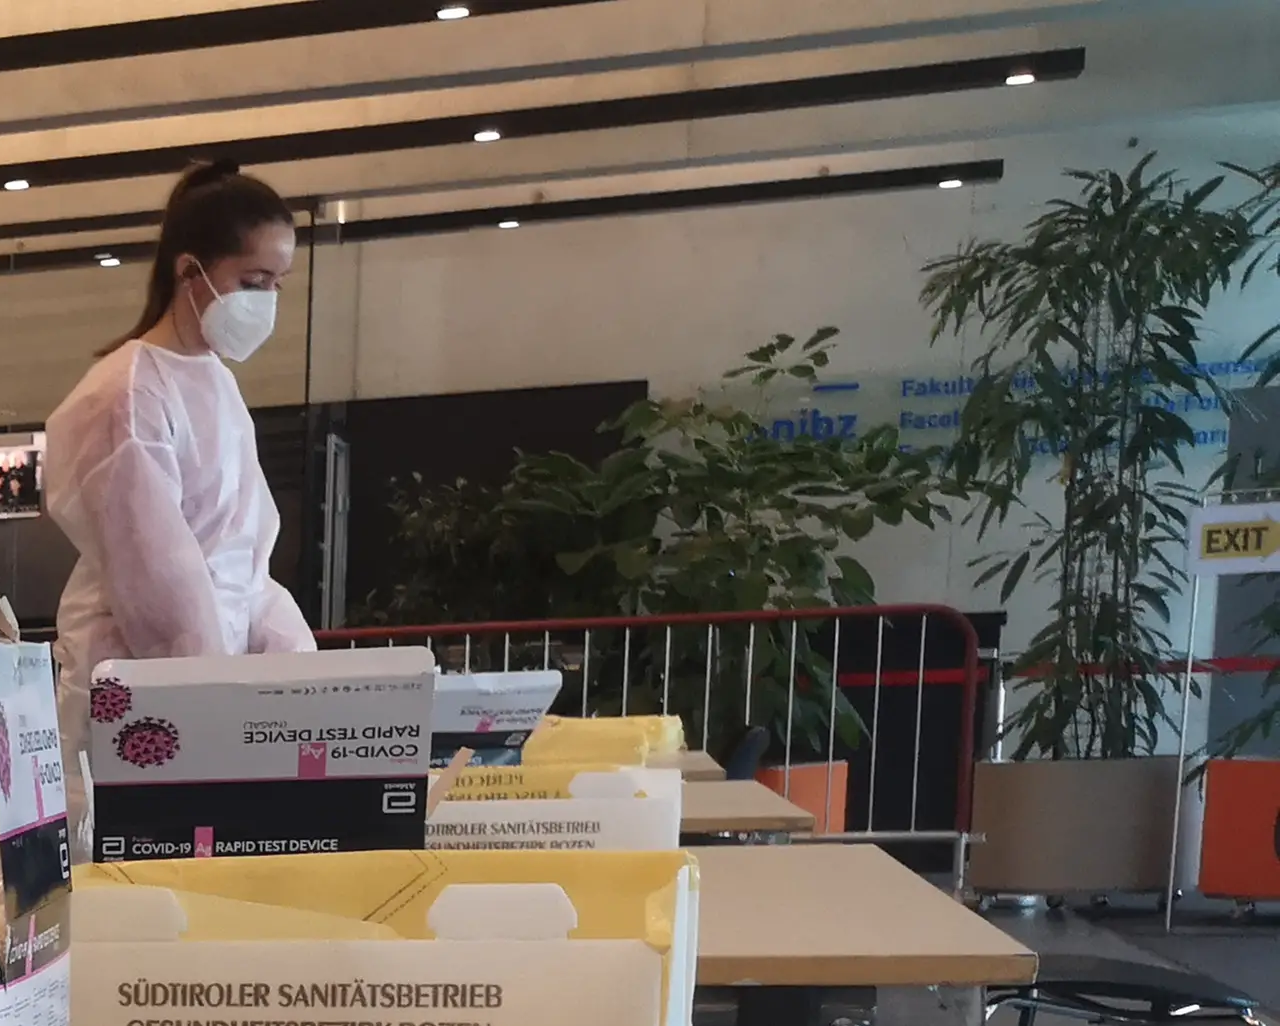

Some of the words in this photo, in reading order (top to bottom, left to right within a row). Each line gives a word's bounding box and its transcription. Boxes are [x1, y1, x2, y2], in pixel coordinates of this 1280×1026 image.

[901, 375, 975, 397] Fakult
[899, 410, 962, 430] Facol
[1206, 526, 1270, 554] EXIT
[243, 729, 312, 744] DEVICE
[315, 726, 361, 742] TEST
[363, 724, 420, 740] RAPID
[331, 744, 419, 759] COVID-19
[426, 822, 488, 837] DTIROLER
[132, 842, 192, 856] COVID-19
[215, 841, 256, 854] RAPID
[257, 840, 289, 852] TEST
[289, 839, 339, 852] DEVICE
[118, 979, 271, 1008] SÜDTIROLER
[278, 978, 503, 1009] SANITÄTSBETRIEB
